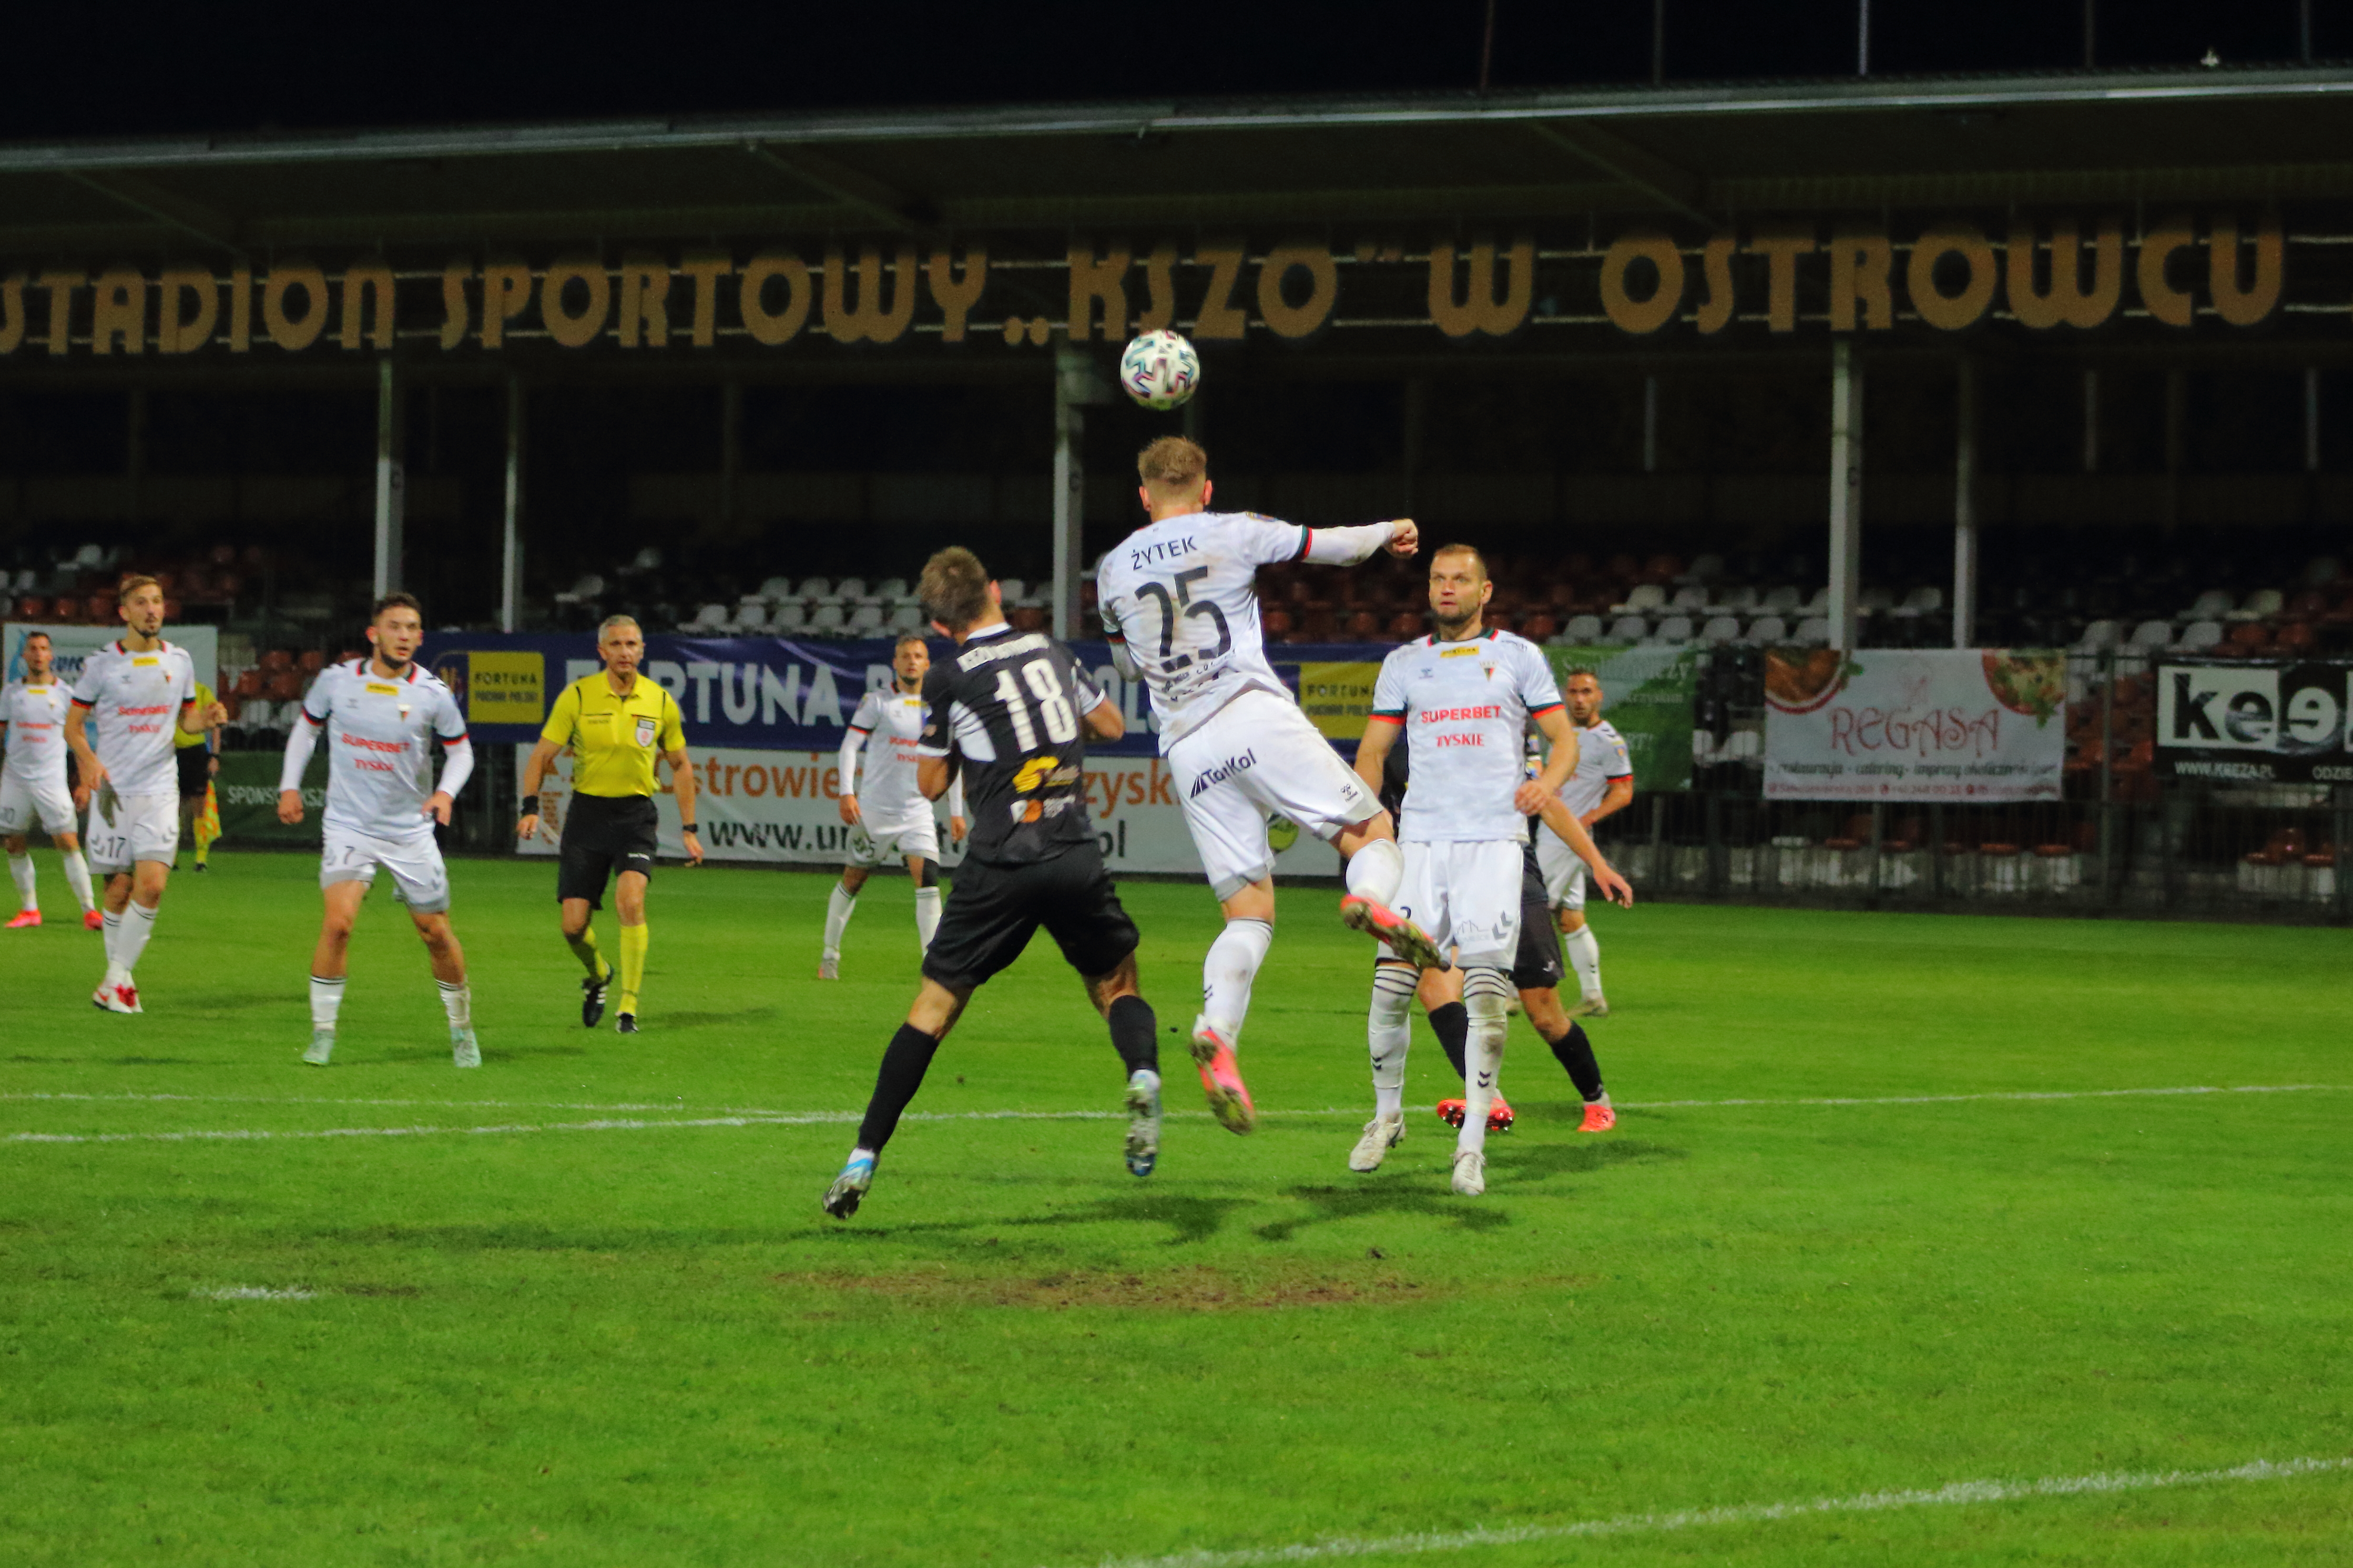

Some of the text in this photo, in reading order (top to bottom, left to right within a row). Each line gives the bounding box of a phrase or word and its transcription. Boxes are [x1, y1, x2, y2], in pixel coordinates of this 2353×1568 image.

[440, 250, 987, 351] SPORTOWY
[1428, 242, 1534, 337] W
[1600, 231, 2283, 334] OSTROWCU
[1130, 535, 1198, 571] ŻYTEK
[1134, 565, 1231, 673] 25
[994, 658, 1080, 754] 18
[1421, 705, 1502, 724] SUPERBET
[341, 733, 411, 754] SUPERBET
[1435, 733, 1485, 749] TYSKIE
[1827, 706, 1999, 758] REGASA
[106, 836, 127, 858] 17
[342, 845, 355, 865] 7
